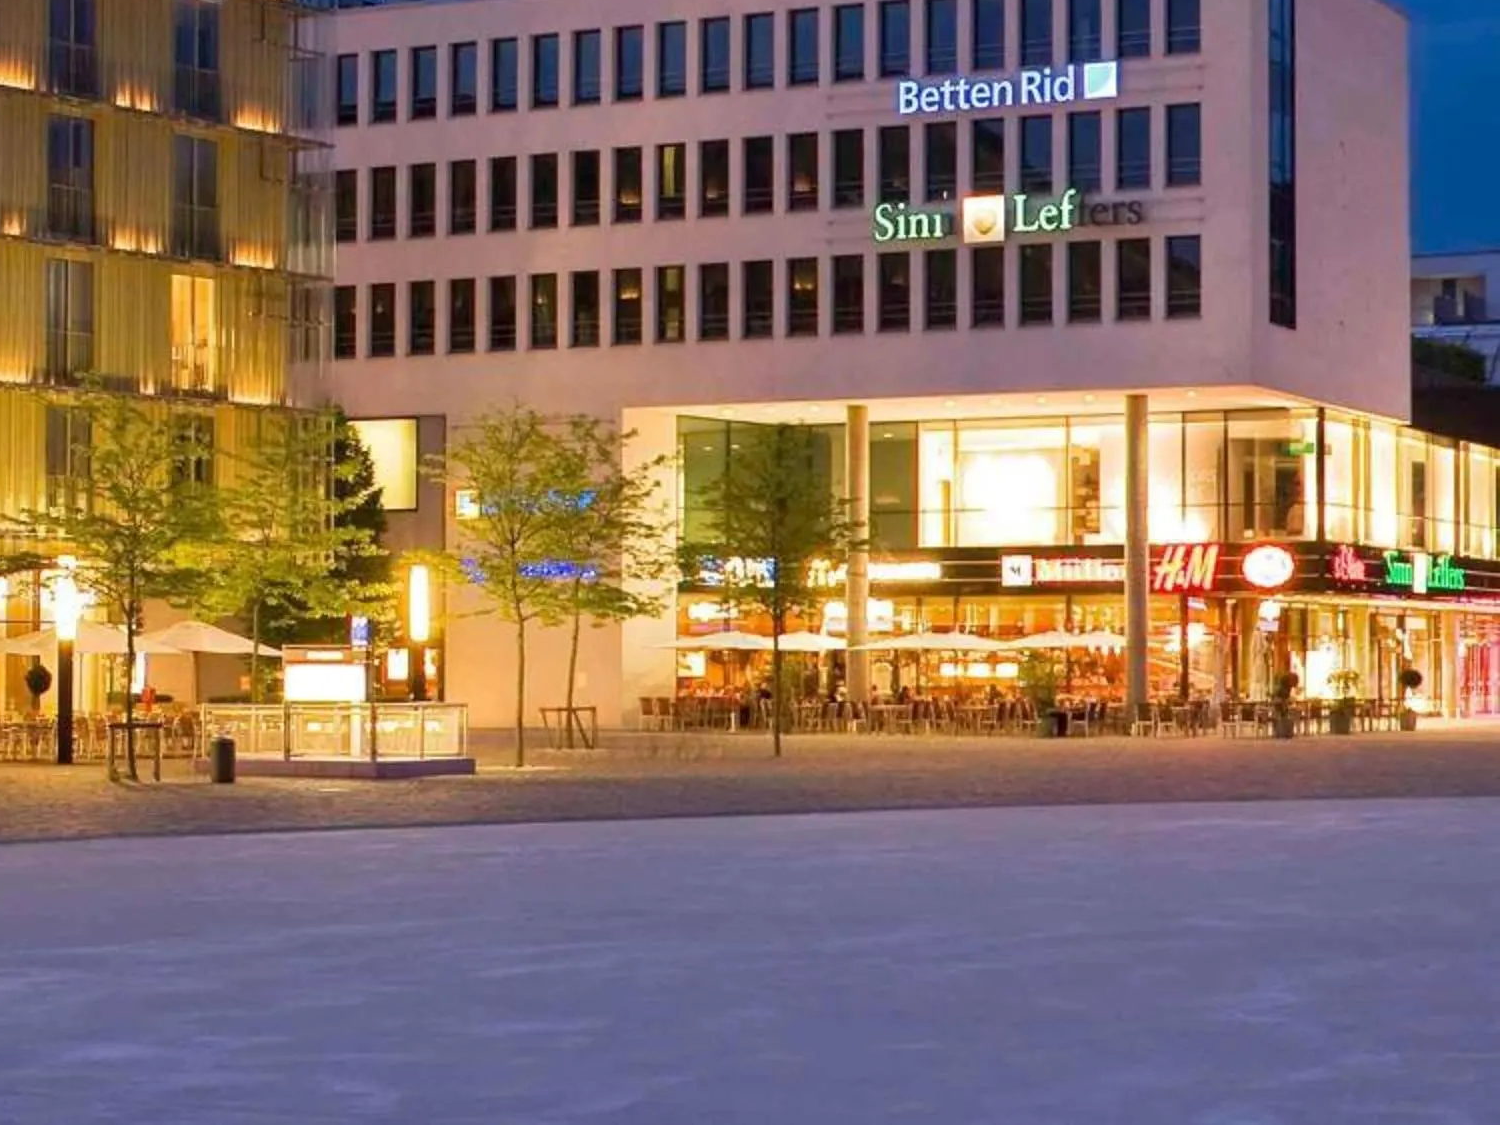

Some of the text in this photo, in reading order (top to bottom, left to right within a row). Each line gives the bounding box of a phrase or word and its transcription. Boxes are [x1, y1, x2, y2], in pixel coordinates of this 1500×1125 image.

[899, 64, 1074, 114] Betten Rid
[1153, 544, 1218, 591] H&M
